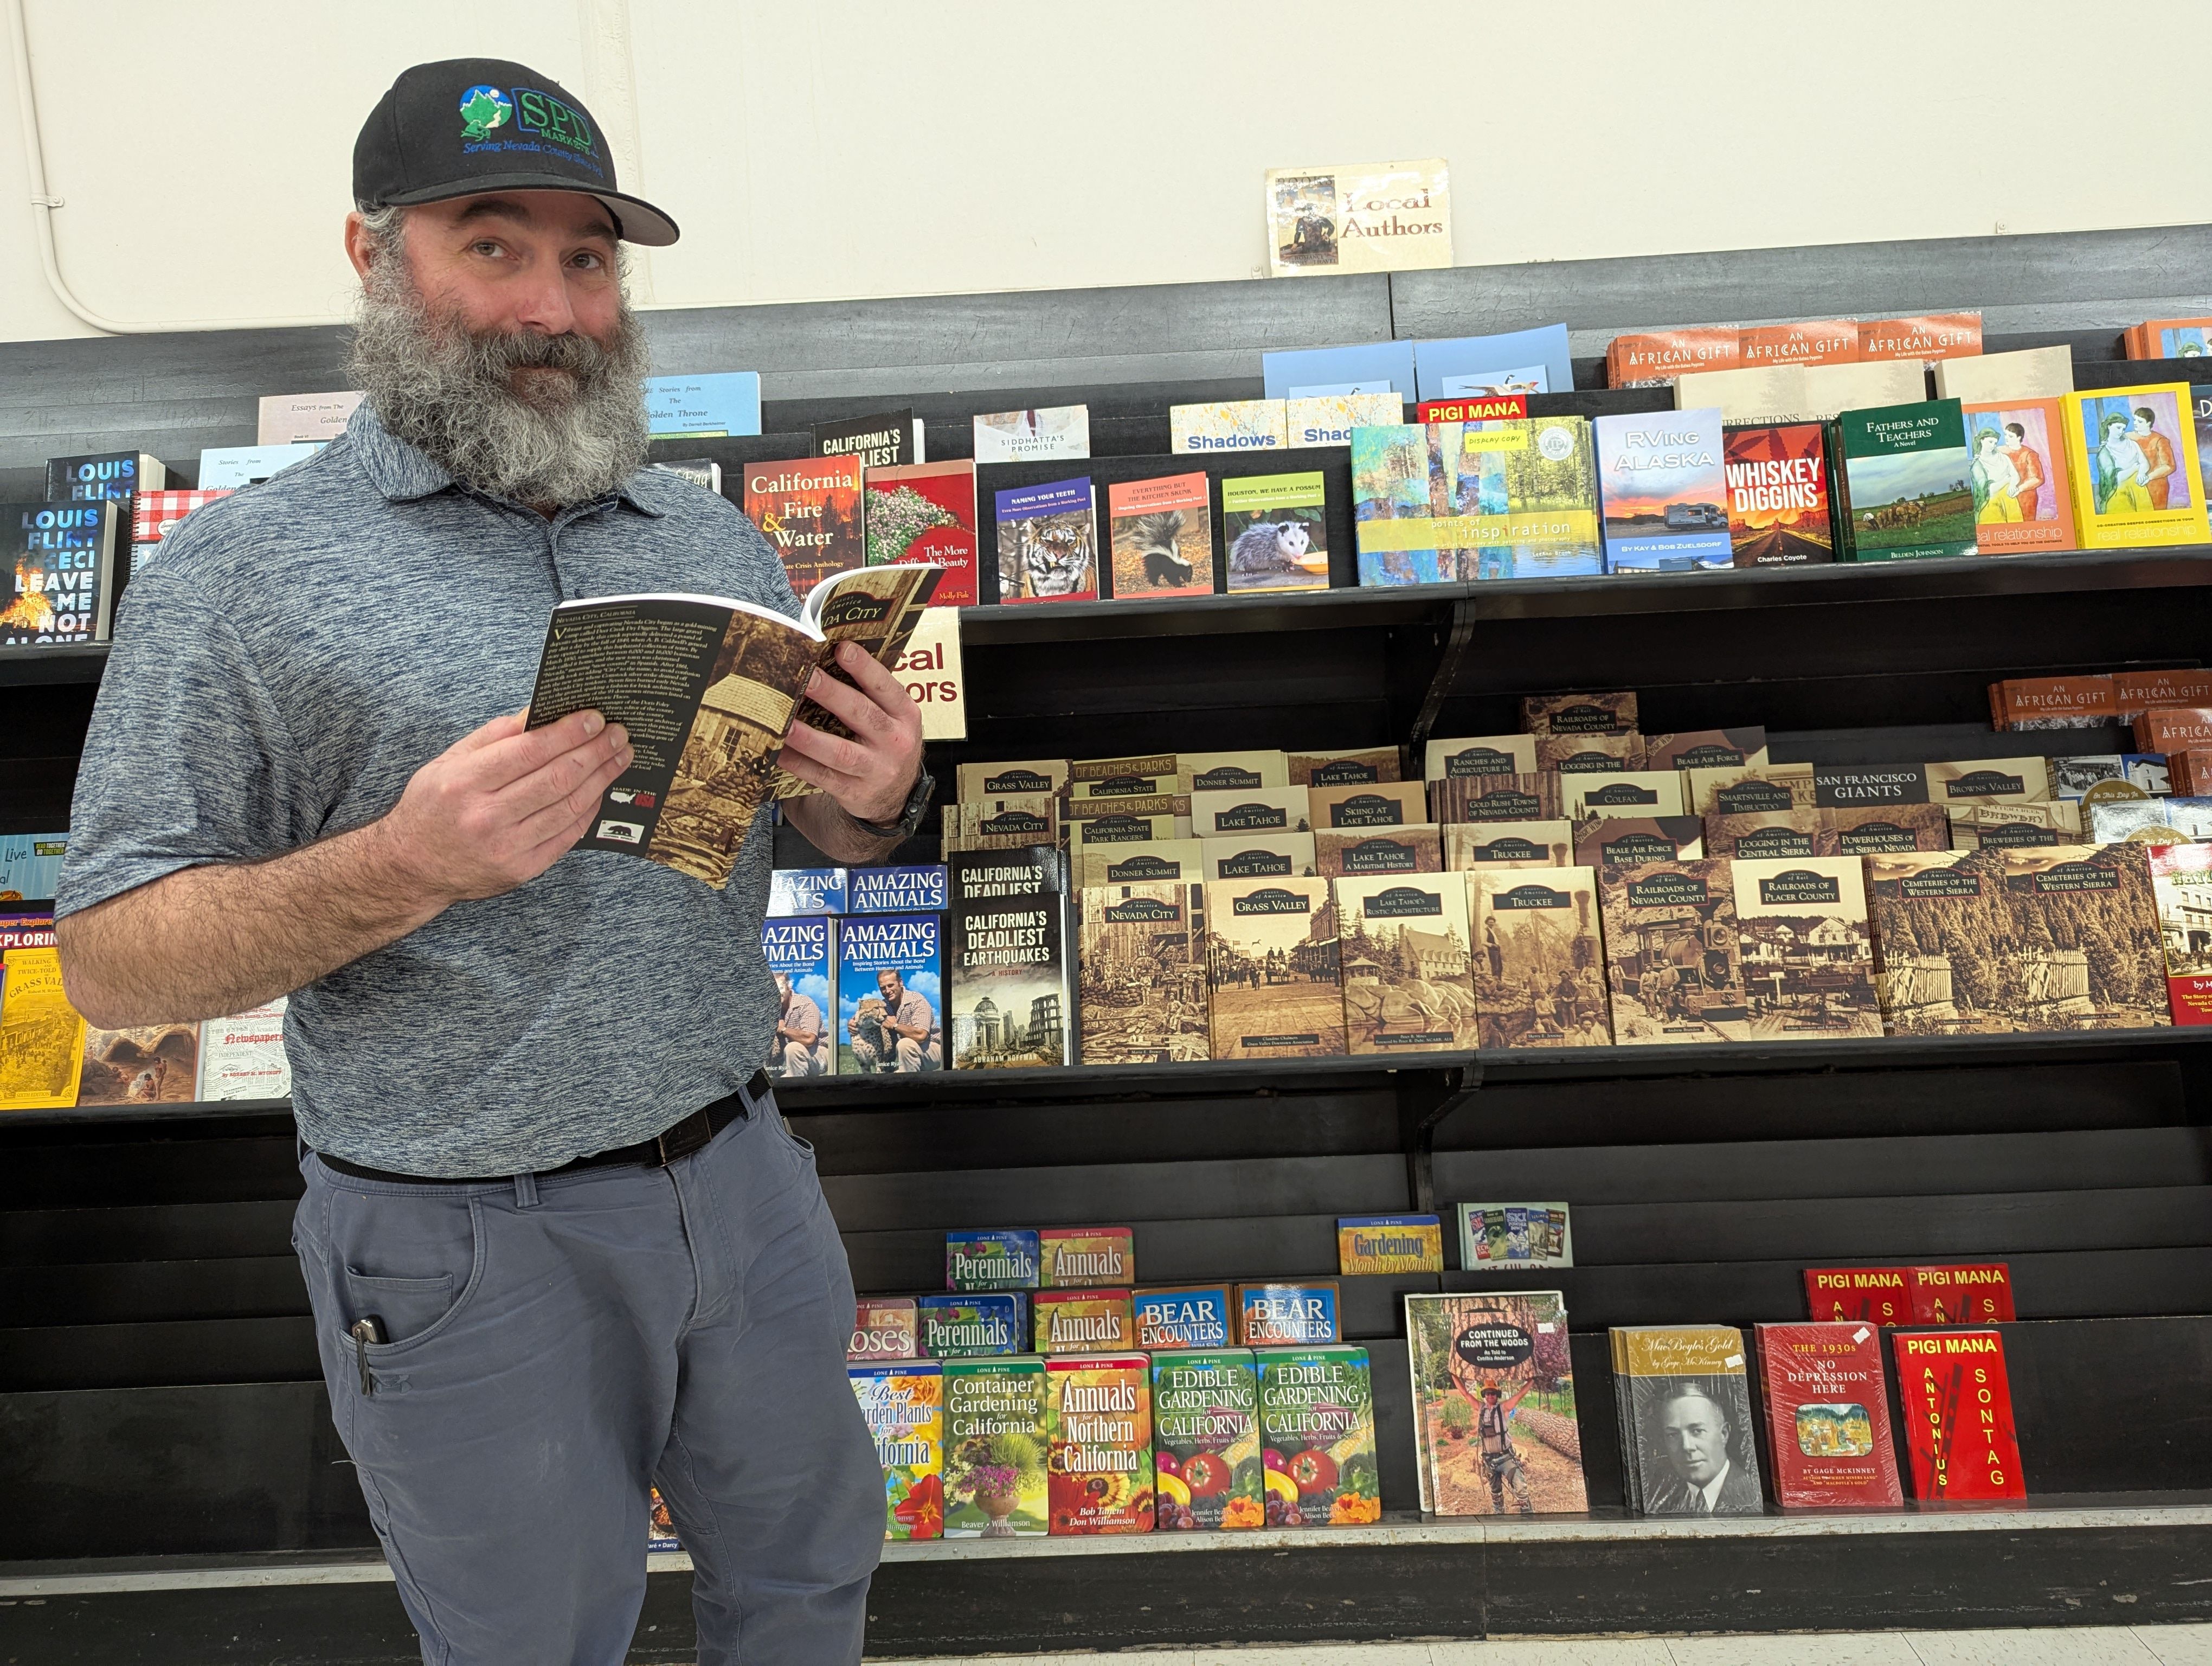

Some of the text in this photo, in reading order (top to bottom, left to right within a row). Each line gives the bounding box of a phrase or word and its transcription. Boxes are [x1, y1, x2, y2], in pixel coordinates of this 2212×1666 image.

[520, 92, 591, 146] SPD
[464, 142, 501, 154] Serving
[503, 141, 540, 152] Nevada
[541, 130, 590, 155] MARKETS
[1343, 189, 1431, 212] Local
[1340, 215, 1443, 238] Authors
[1671, 339, 1685, 348] AN
[1629, 345, 1730, 366] AFRICAN GIFT
[1429, 401, 1521, 421] PIGI MANA
[1866, 416, 1939, 433] FATHERS AND
[824, 429, 900, 454] CALIFORNIA'S
[1001, 436, 1065, 446] SIDDHATTA'S
[1188, 434, 1276, 450] Shadows
[1876, 428, 1932, 444] TEACHERS
[1012, 444, 1055, 452] PROMISE
[1615, 451, 1714, 471] ALASKA
[66, 459, 135, 483] LOUIS
[1725, 458, 1821, 489] WHISKEY
[751, 471, 853, 494] California
[1133, 485, 1172, 494] EVERYTHING
[1012, 496, 1036, 505] NAMING
[1057, 490, 1075, 498] TEETH
[1142, 492, 1169, 501] KITCHEN
[1735, 483, 1818, 512] DIGGINS
[784, 502, 822, 519] Fire
[22, 509, 98, 529] LOUIS
[763, 514, 786, 531] &
[1432, 520, 1464, 528] points
[774, 530, 833, 547] Water
[1462, 522, 1570, 540] inspiration
[1994, 526, 2062, 541] relationship
[28, 530, 97, 550] FLINT
[1677, 541, 1722, 549] ZUELSDORF
[924, 546, 968, 556] The More
[1784, 554, 1807, 562] Coyote
[1891, 548, 1943, 559] BELDEN JOHNSON
[44, 550, 94, 570] CECI
[813, 560, 844, 569] Anthology
[940, 557, 968, 568] Beauty
[14, 572, 93, 592] LEAVE
[56, 592, 91, 612] ME
[846, 607, 882, 620] CITY
[38, 613, 88, 633] NOT
[2016, 691, 2106, 707] AFRICAN GIFT
[987, 780, 1050, 791] GRASS VALLEY
[1816, 773, 1917, 785] SAN FRANCISCO
[1835, 785, 1902, 798] GIANTS
[1949, 781, 2021, 794] BROWNS VALLEY
[635, 793, 656, 808] USA
[1604, 796, 1637, 804] COLFAX
[1345, 808, 1374, 816] SKIING
[986, 822, 1044, 833] NEVADA CITY
[1221, 816, 1281, 826] LAKE TAHOE
[1341, 816, 1394, 825] LAKE TAHOE
[1739, 838, 1779, 848] LOGGING
[1793, 837, 1809, 845] THE
[5, 848, 27, 863] Live
[1738, 847, 1811, 858] CENTRAL SIERRA
[1111, 868, 1177, 878] DONNER SUMMIT
[1769, 882, 1816, 891] RAILROADS
[1511, 898, 1553, 906] TRUCKEE
[1765, 892, 1835, 902] PLACER COUNTY
[965, 911, 1047, 930] CALIFORNIA'S
[843, 922, 936, 944] AMAZING
[968, 928, 1044, 950] DEADLIEST
[844, 940, 935, 960] ANIMALS
[963, 947, 1050, 966] EARTHQUAKES
[999, 969, 1023, 977] HISTORY
[223, 1033, 283, 1046] Newspapers
[973, 1055, 1004, 1063] ABRAHAM
[1354, 1233, 1424, 1258] Gardening
[1348, 1255, 1433, 1272] Month by Month
[1144, 1300, 1217, 1326] BEAR
[928, 1317, 1007, 1348] Perennials
[1141, 1321, 1224, 1345] ENCOUNTERS
[1469, 1329, 1519, 1340] CONTINUED
[1461, 1340, 1482, 1348] FROM
[1484, 1339, 1499, 1347] THE
[1641, 1338, 1733, 1354] MacBoyle's Gold
[1793, 1343, 1856, 1353] THE 1930s
[1908, 1338, 1997, 1355] PIGI MANA
[1817, 1360, 1836, 1370] NO
[1173, 1369, 1238, 1389] EDIBLE
[1788, 1371, 1867, 1383] DEPRESSION
[953, 1379, 1034, 1395] Container
[1812, 1383, 1846, 1394] HERE
[1063, 1380, 1135, 1413] Annuals
[1159, 1387, 1252, 1409] GARDENING
[950, 1396, 1038, 1414] Gardening
[953, 1418, 1036, 1436] California
[1067, 1417, 1134, 1444] Northern
[1160, 1416, 1255, 1438] CALIFORNIA
[1064, 1443, 1137, 1472] California
